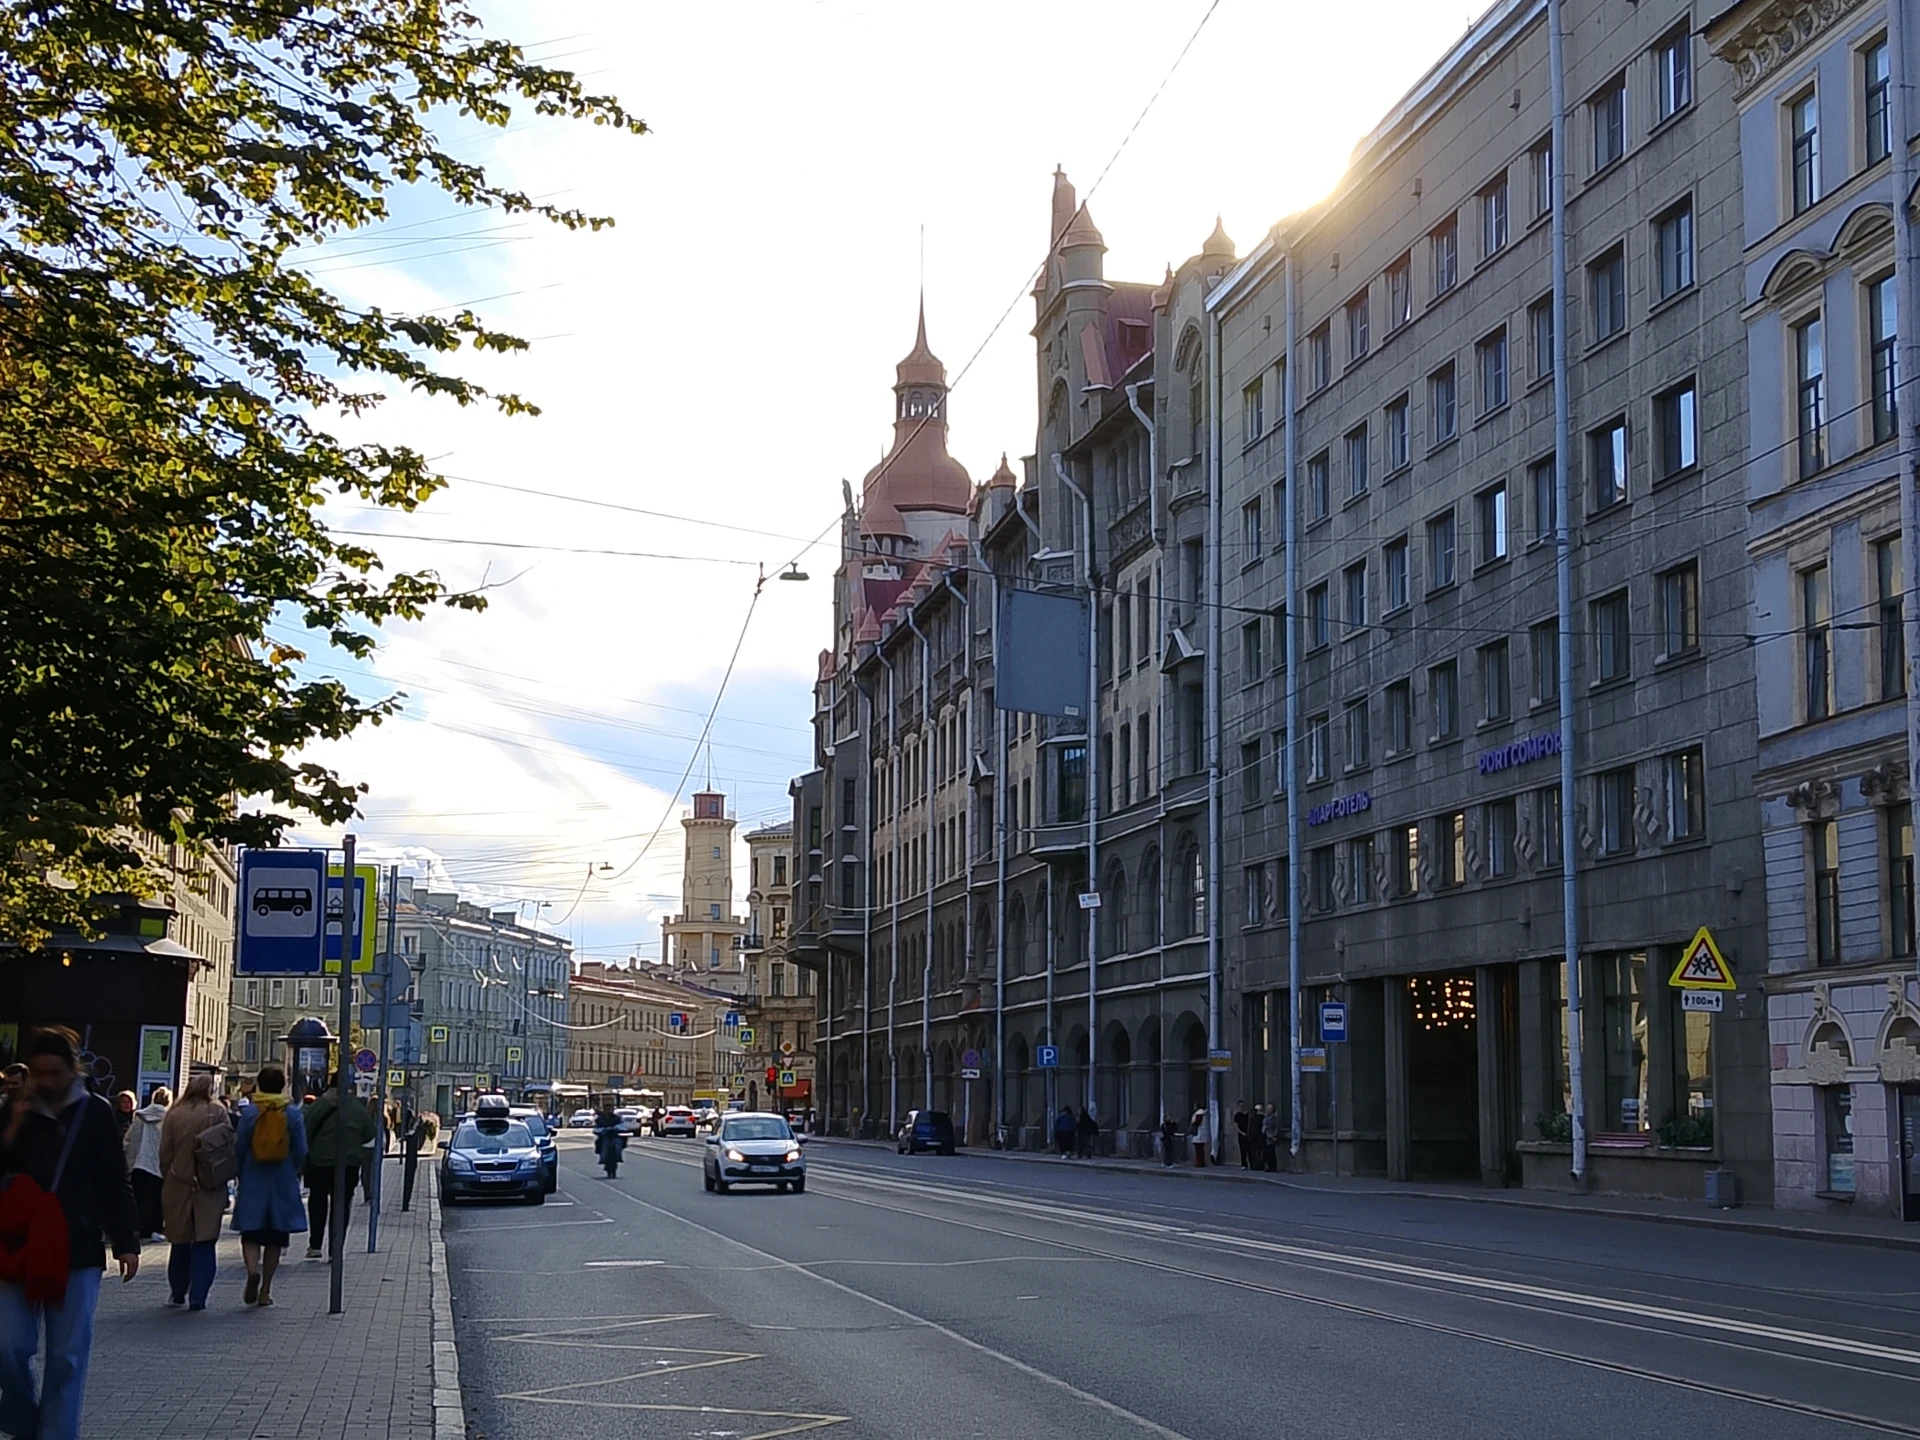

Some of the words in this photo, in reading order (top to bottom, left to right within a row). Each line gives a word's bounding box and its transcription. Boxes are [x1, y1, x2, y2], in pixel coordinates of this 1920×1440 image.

[1478, 746, 1510, 774] PORT
[1510, 732, 1562, 766] COMFOR
[1308, 792, 1369, 826] АПАРТ-ОТЕЛЬ
[1043, 1048, 1055, 1065] P
